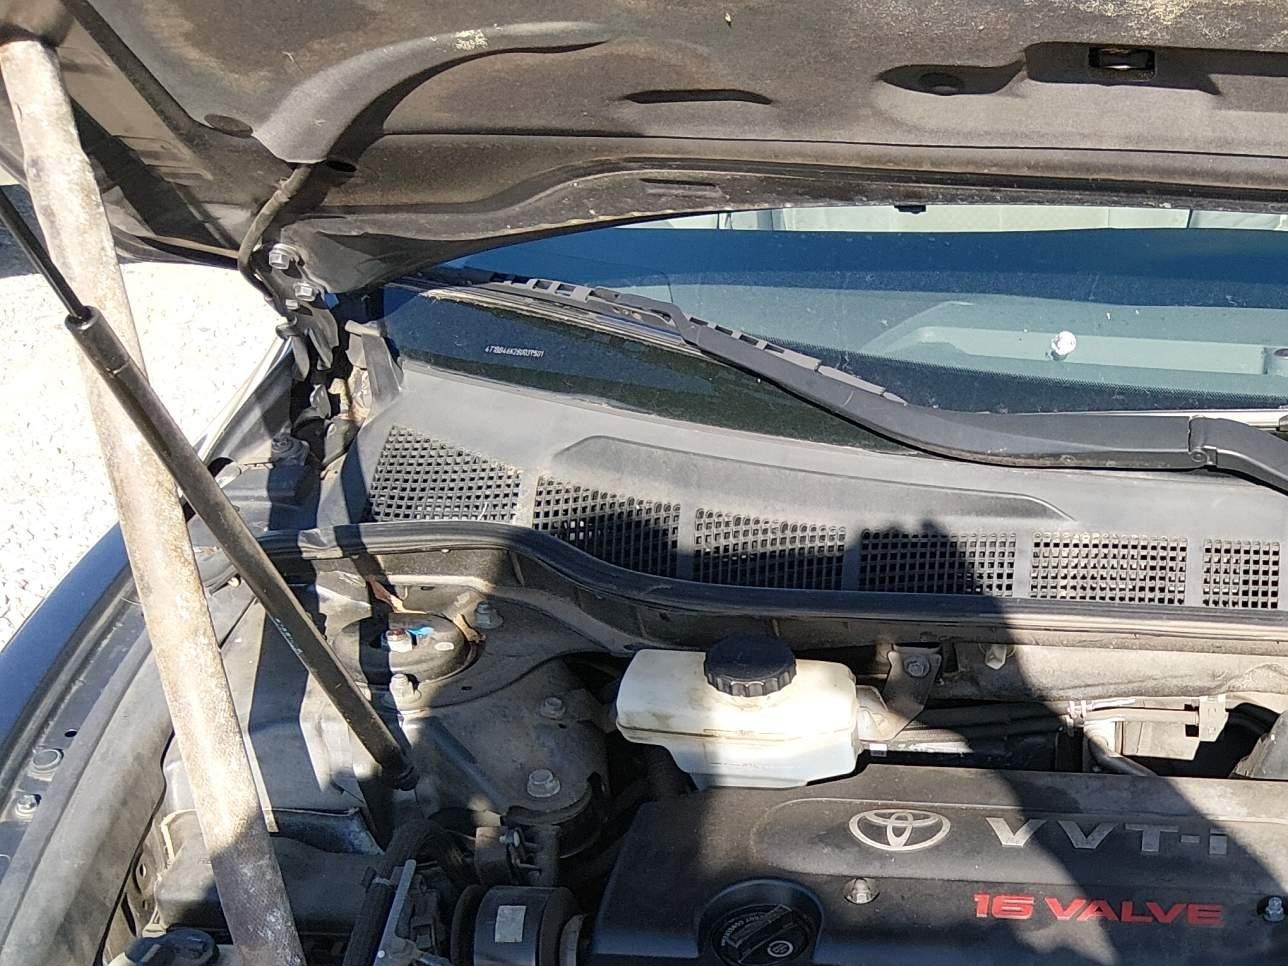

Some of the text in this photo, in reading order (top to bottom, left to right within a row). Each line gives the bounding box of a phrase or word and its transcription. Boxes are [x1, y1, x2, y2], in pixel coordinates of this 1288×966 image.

[986, 816, 1228, 855] VVT-i
[973, 892, 1226, 928] 16 VALVE
